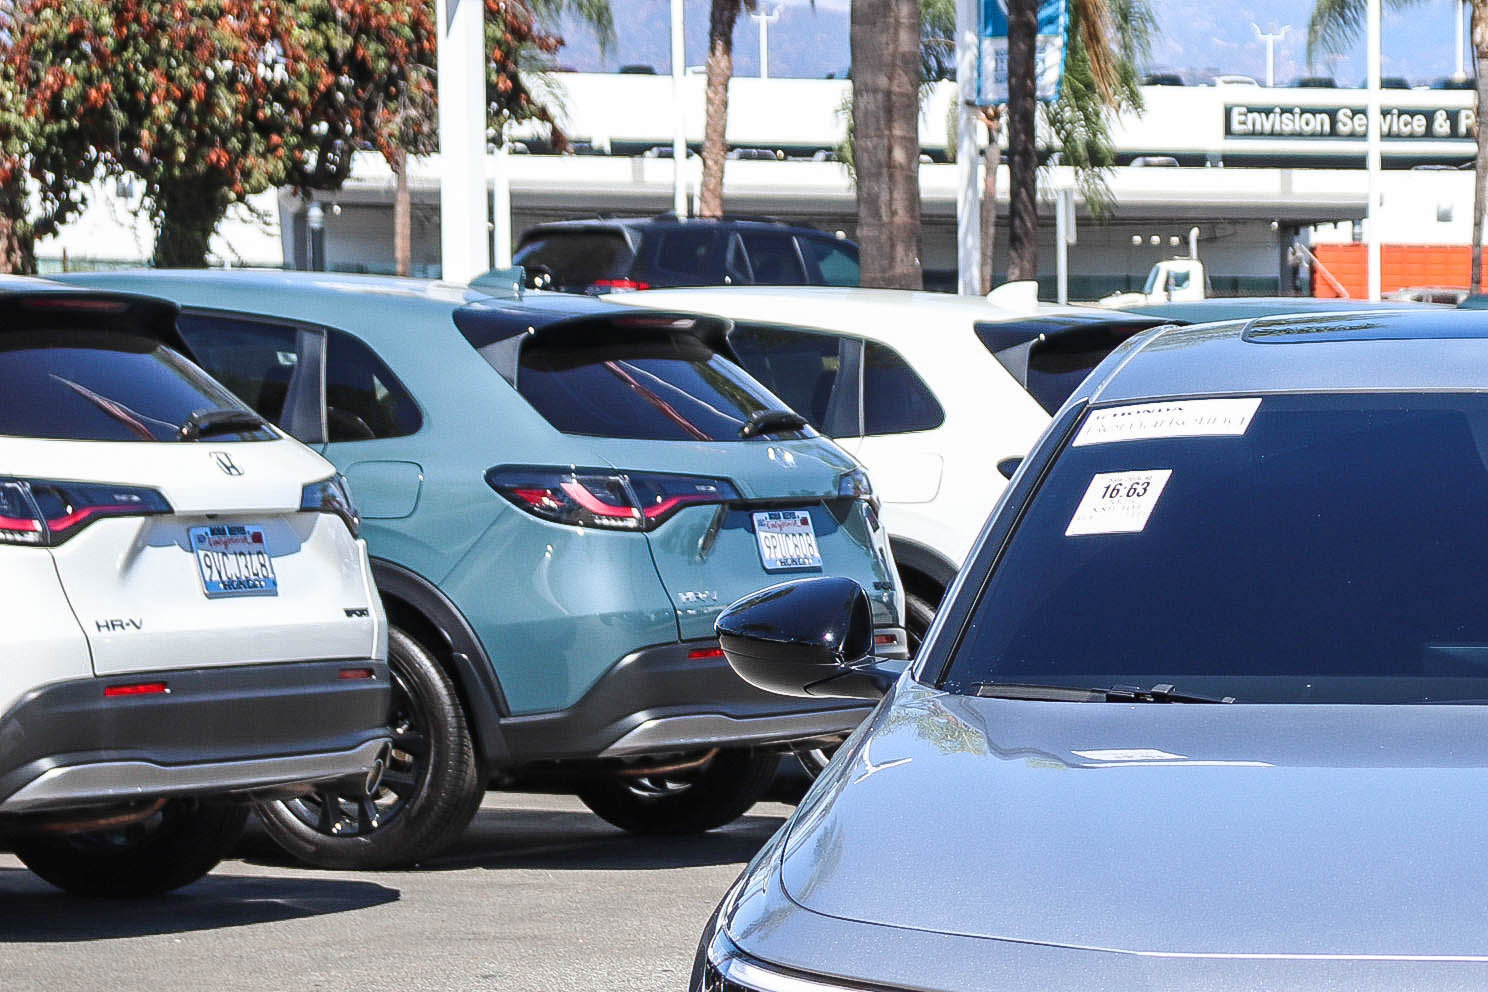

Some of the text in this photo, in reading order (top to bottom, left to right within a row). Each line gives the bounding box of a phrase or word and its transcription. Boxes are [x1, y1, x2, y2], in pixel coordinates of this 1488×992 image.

[1230, 106, 1331, 136] Envision
[1335, 107, 1427, 138] Sevice
[1432, 108, 1451, 138] &
[95, 618, 143, 632] HR-V
